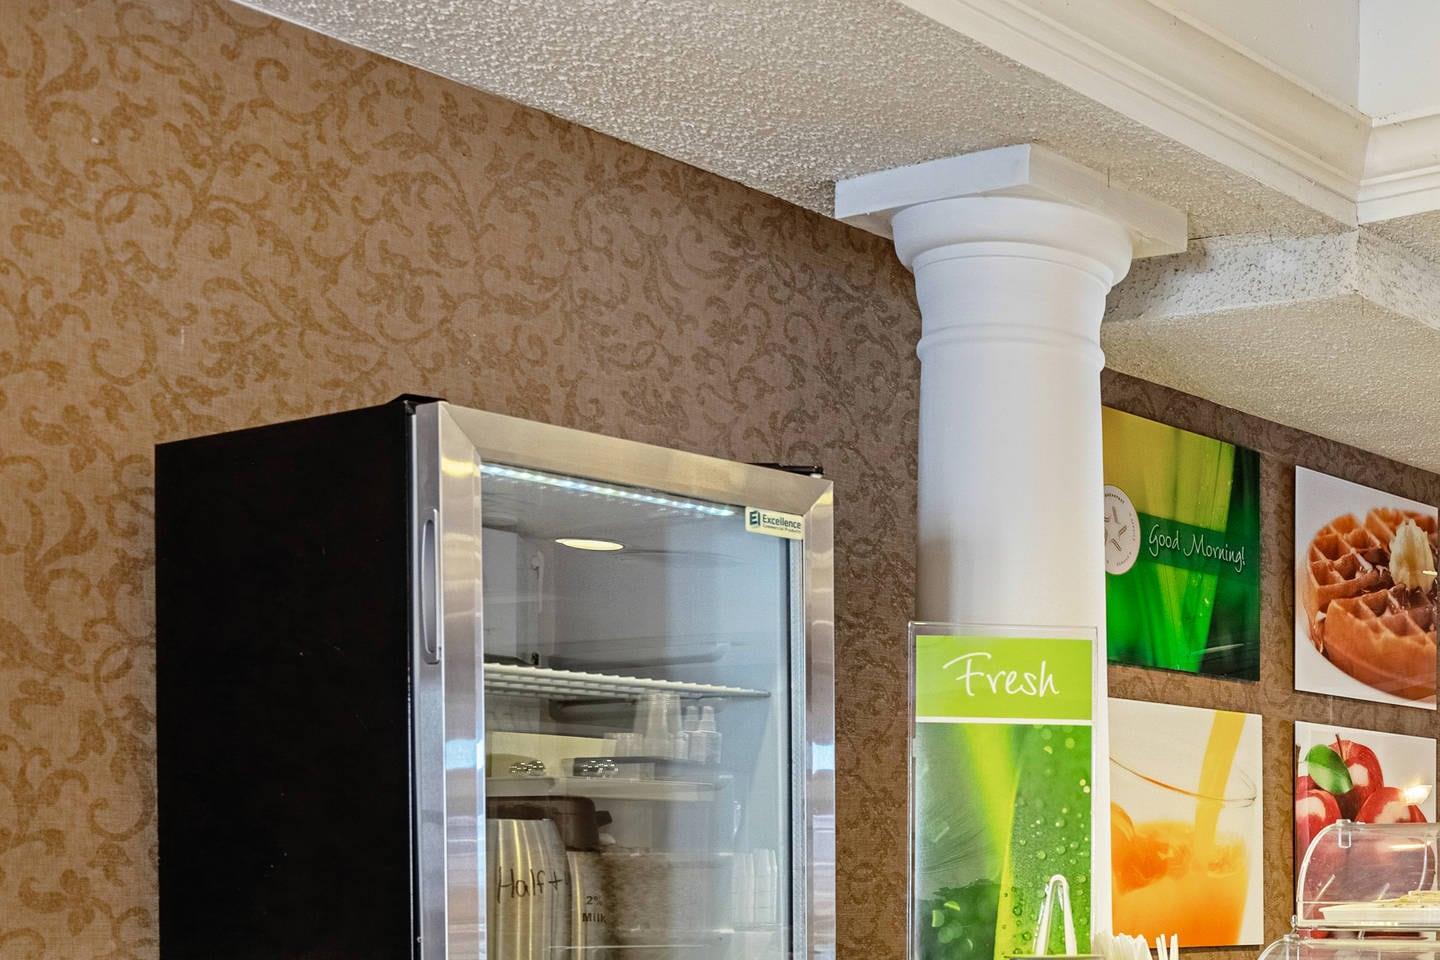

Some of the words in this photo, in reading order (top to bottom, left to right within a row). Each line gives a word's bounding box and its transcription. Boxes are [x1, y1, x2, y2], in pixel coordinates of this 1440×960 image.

[762, 513, 802, 529] Excellence
[1149, 524, 1180, 557] Good
[1183, 534, 1246, 573] Morning!
[942, 652, 1060, 698] Fresh
[497, 866, 545, 904] Half
[581, 912, 607, 924] Milk
